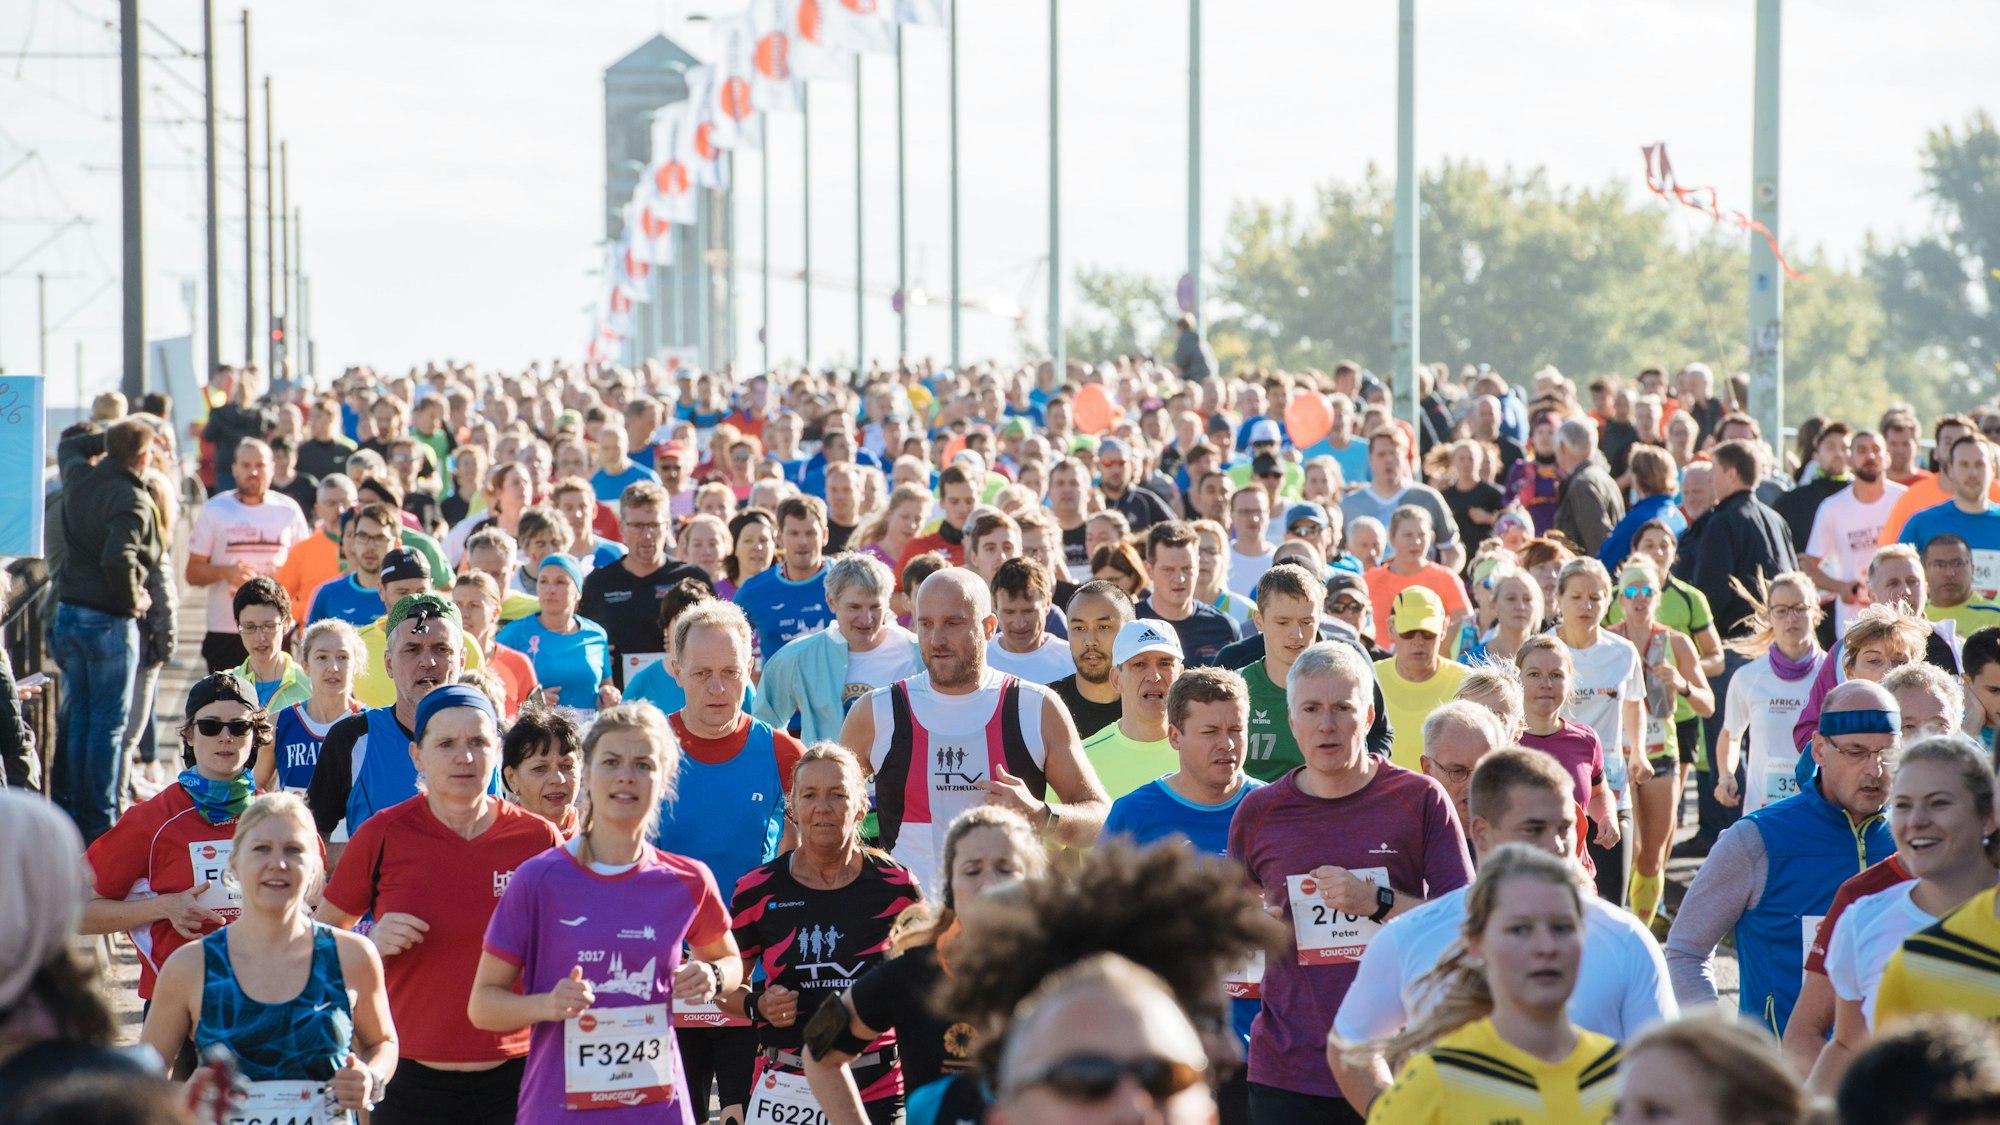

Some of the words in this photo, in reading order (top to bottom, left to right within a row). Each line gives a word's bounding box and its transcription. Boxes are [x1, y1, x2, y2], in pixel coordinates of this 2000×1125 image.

[1137, 634, 1160, 643] adidas
[1769, 698, 1801, 706] AFRICA
[1252, 717, 1271, 725] erima
[1250, 732, 1277, 760] 17
[286, 741, 323, 768] FRA
[934, 771, 984, 784] TV
[1331, 930, 1360, 938] Peter
[577, 950, 606, 962] 2017
[1319, 946, 1362, 958] saucony
[795, 960, 866, 980] TV
[683, 1013, 721, 1022] saucony
[579, 1038, 660, 1068] F3243
[609, 1071, 633, 1081] Julia
[591, 1090, 637, 1102] saucony
